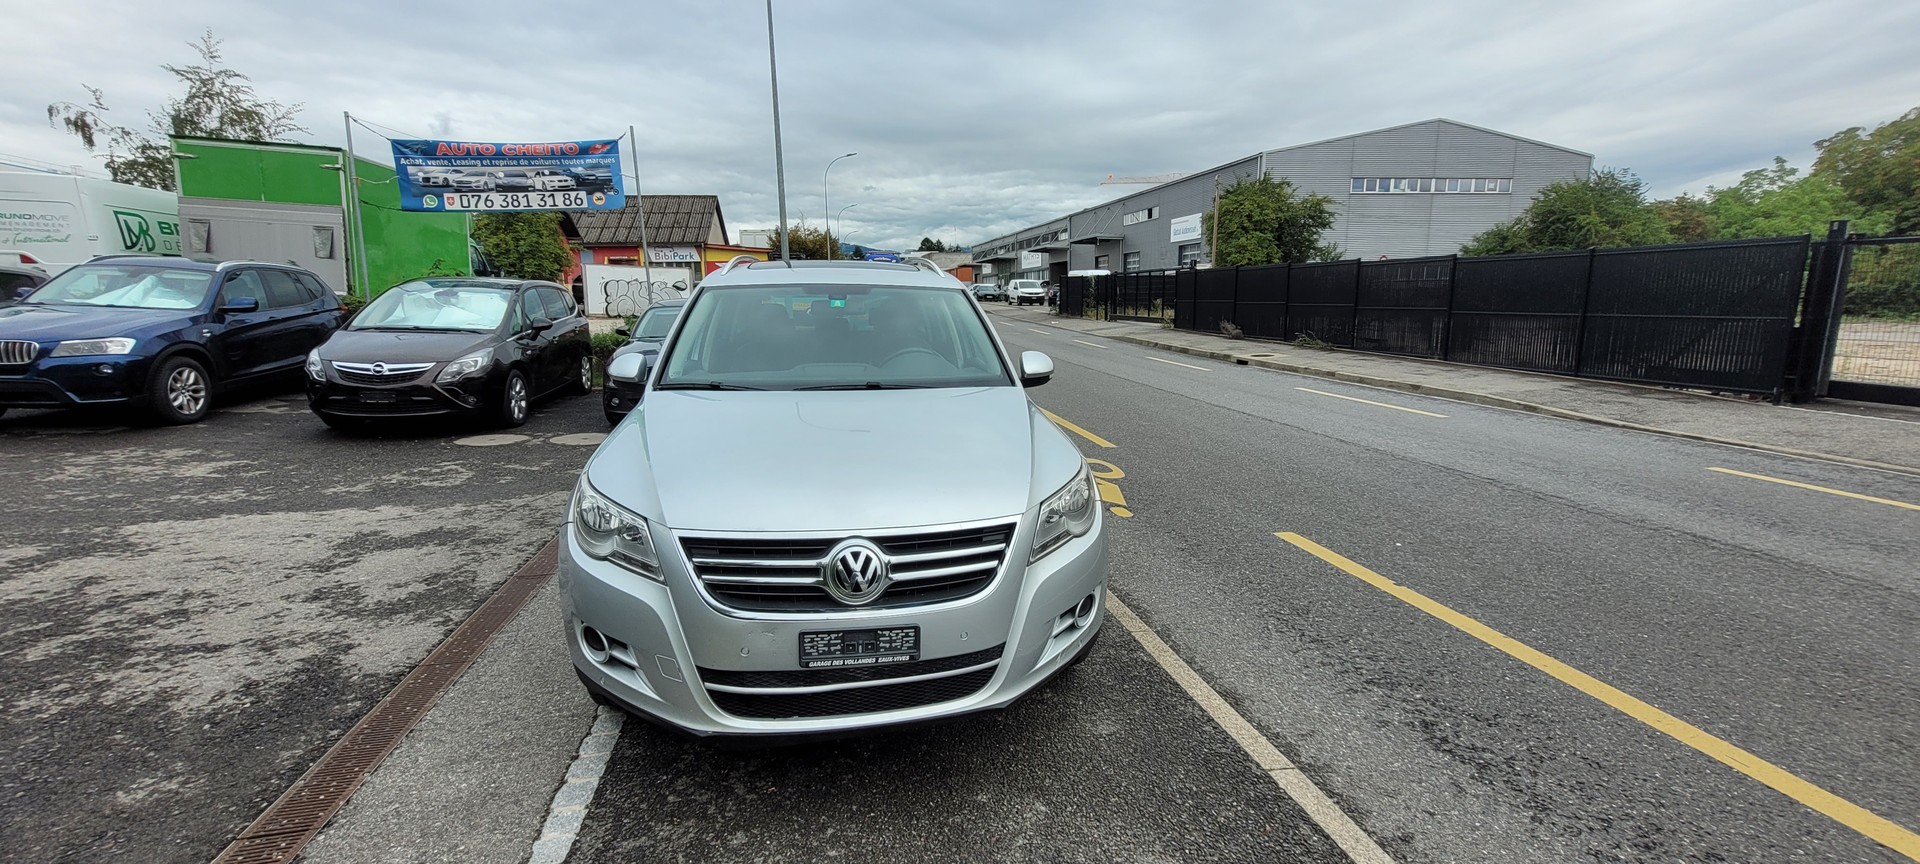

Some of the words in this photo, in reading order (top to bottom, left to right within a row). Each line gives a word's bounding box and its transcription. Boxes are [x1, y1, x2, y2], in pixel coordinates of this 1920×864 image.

[436, 142, 496, 155] AUTO
[501, 143, 579, 155] CHEITO
[452, 159, 481, 167] Leasing
[492, 158, 518, 167] reprise
[530, 158, 560, 166] voitures
[586, 157, 616, 165] marques
[460, 194, 495, 209] 076
[499, 193, 533, 208] 381
[536, 193, 559, 207] 31
[562, 192, 584, 207] 86
[654, 252, 695, 260] BibiPark
